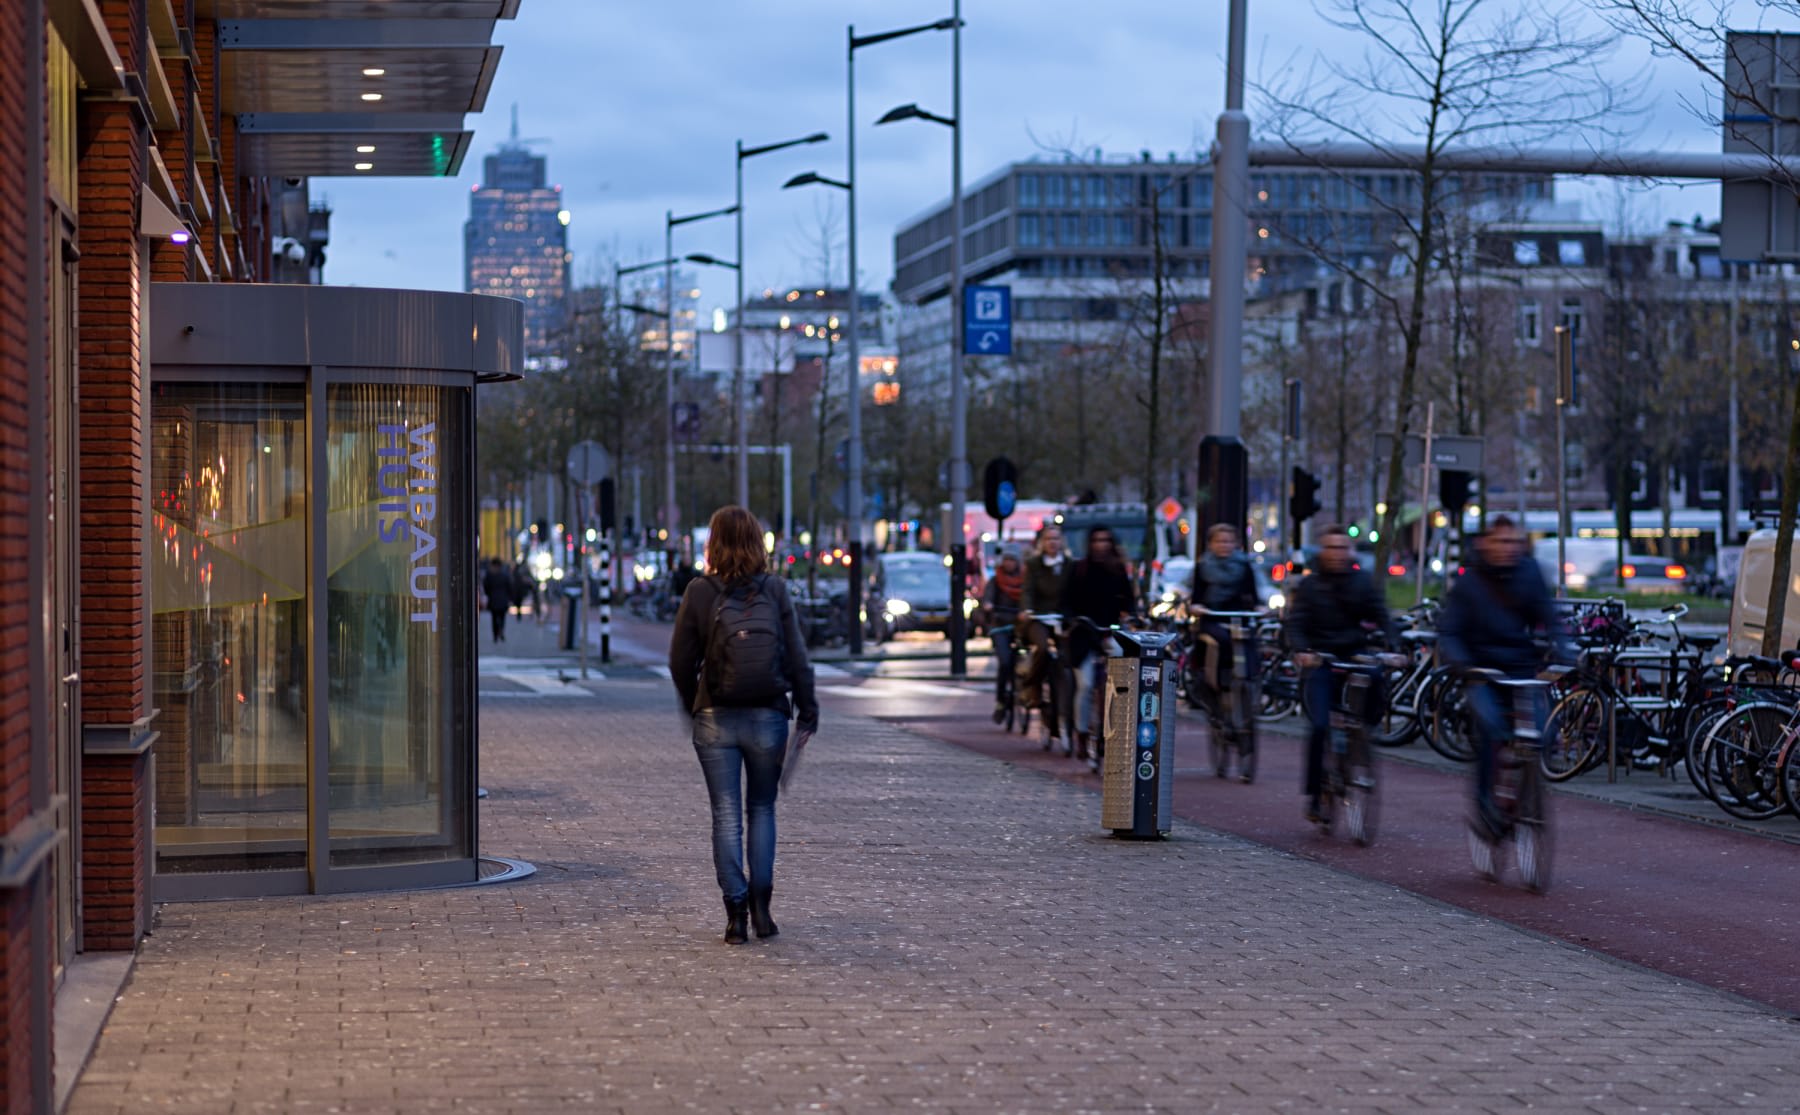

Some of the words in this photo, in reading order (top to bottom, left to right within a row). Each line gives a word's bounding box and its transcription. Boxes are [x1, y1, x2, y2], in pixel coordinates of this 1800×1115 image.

[983, 300, 996, 315] P
[377, 423, 409, 543] HUIS
[409, 422, 438, 632] WIBAUT
